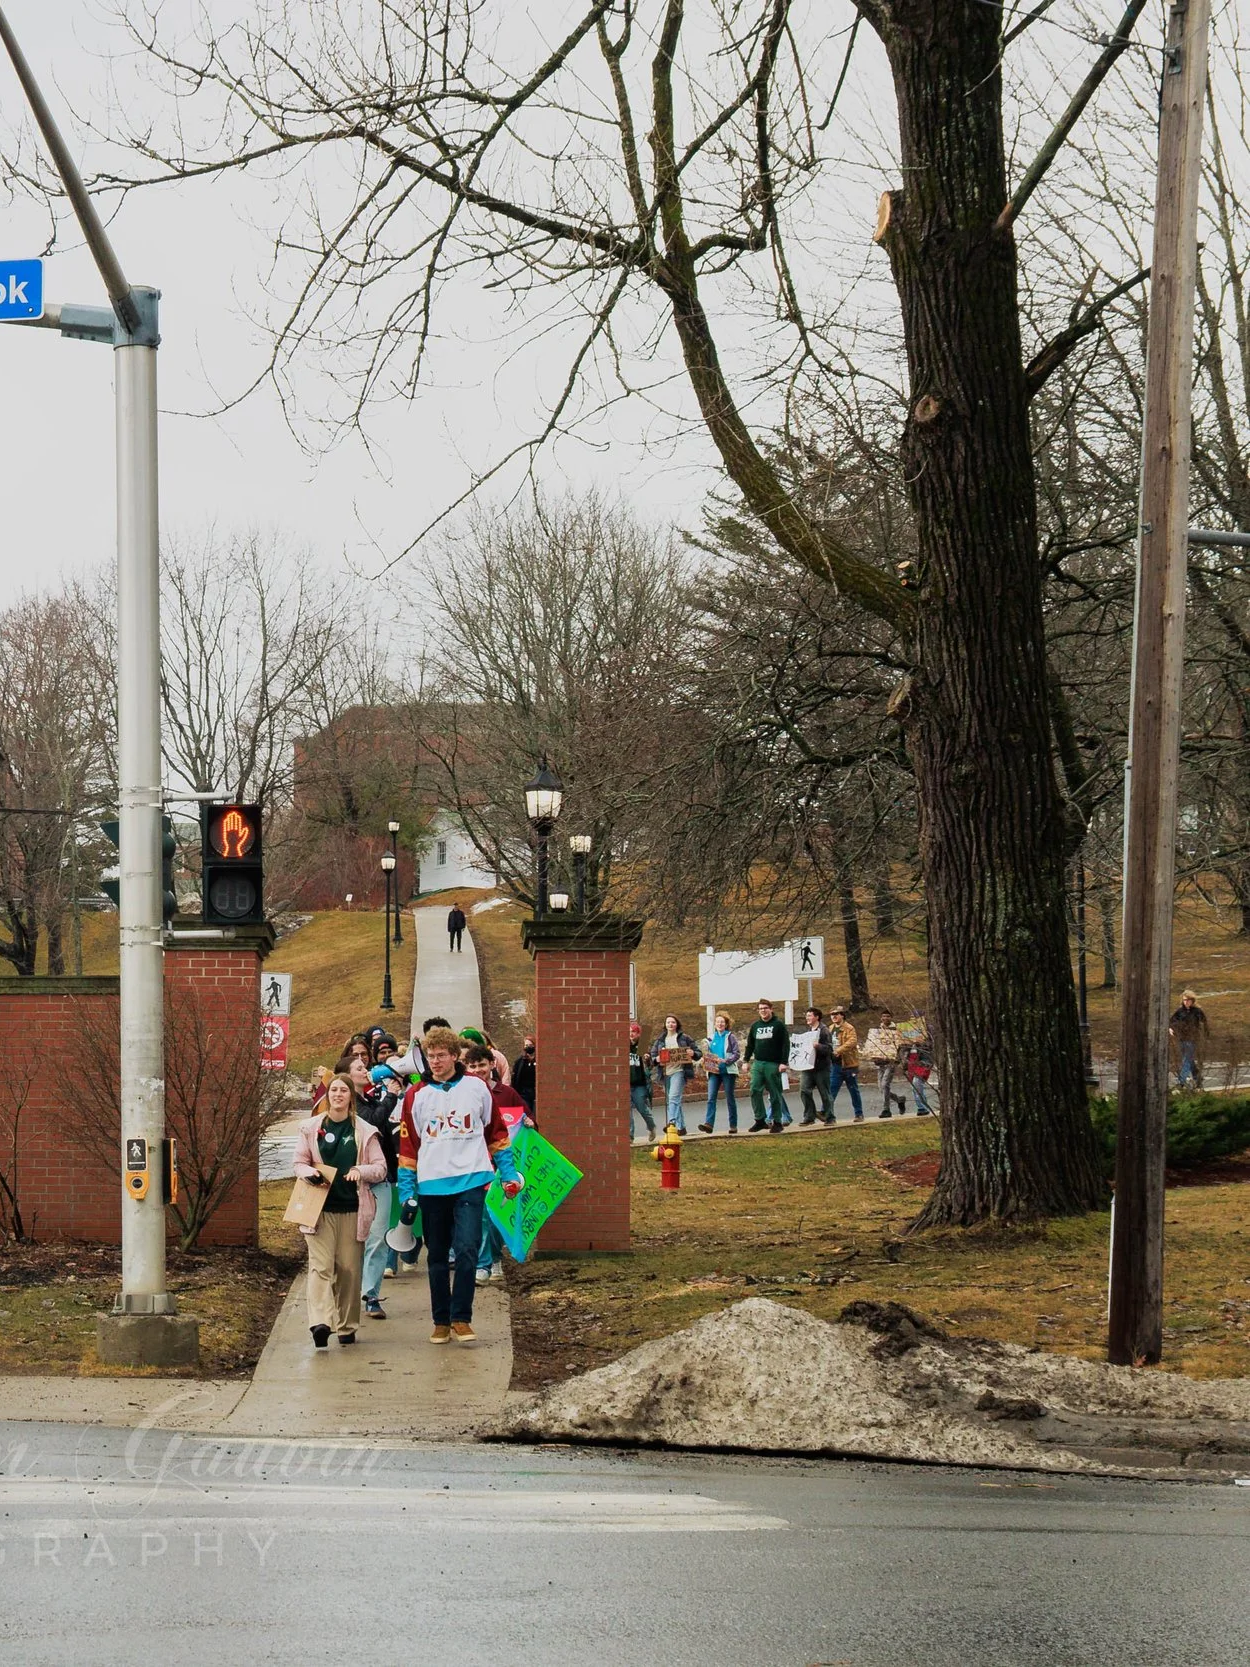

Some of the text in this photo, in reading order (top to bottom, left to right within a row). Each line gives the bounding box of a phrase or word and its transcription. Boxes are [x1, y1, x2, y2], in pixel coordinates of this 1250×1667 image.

[525, 1145, 541, 1171] CUT
[533, 1158, 558, 1187] THEY
[547, 1170, 573, 1201] HEY
